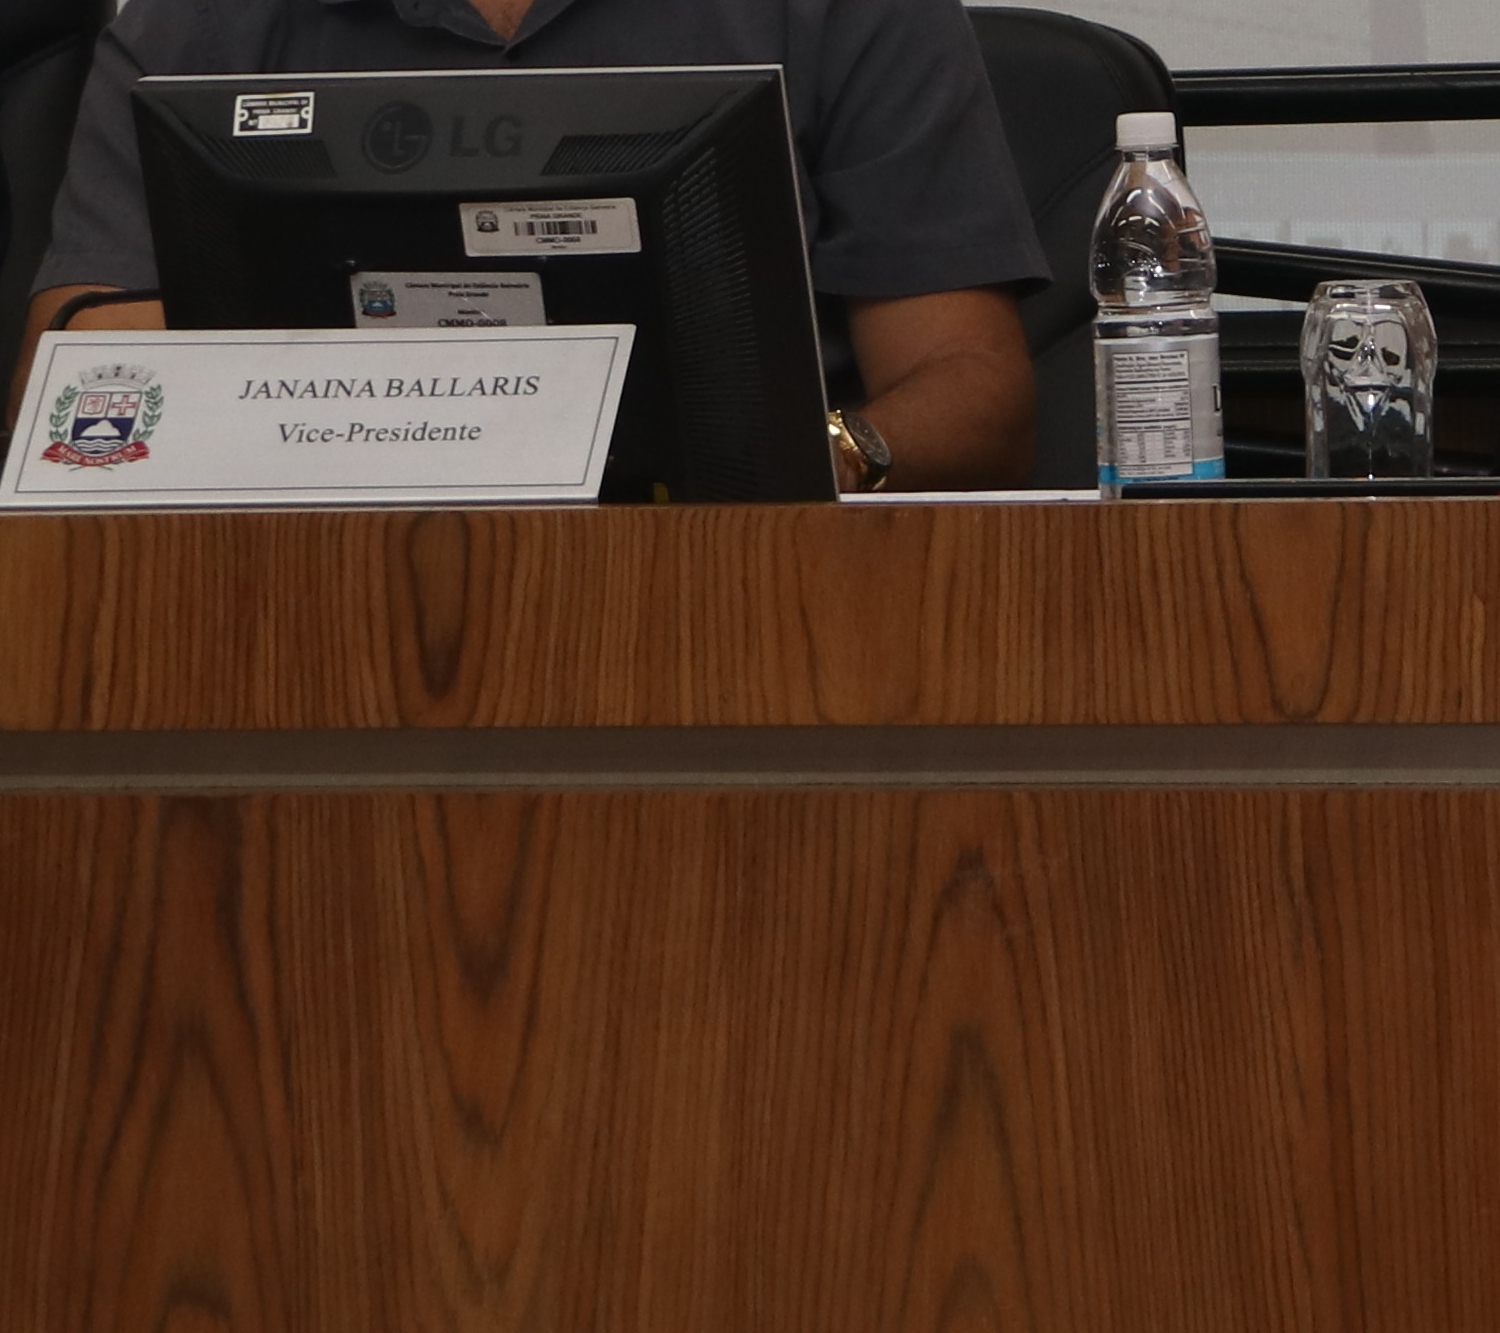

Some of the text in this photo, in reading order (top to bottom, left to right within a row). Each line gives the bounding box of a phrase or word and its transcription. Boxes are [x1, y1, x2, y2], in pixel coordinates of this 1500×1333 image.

[450, 114, 523, 158] LG
[237, 375, 541, 401] JANAINA BALLARIS
[278, 420, 483, 444] Vice-Presidente
